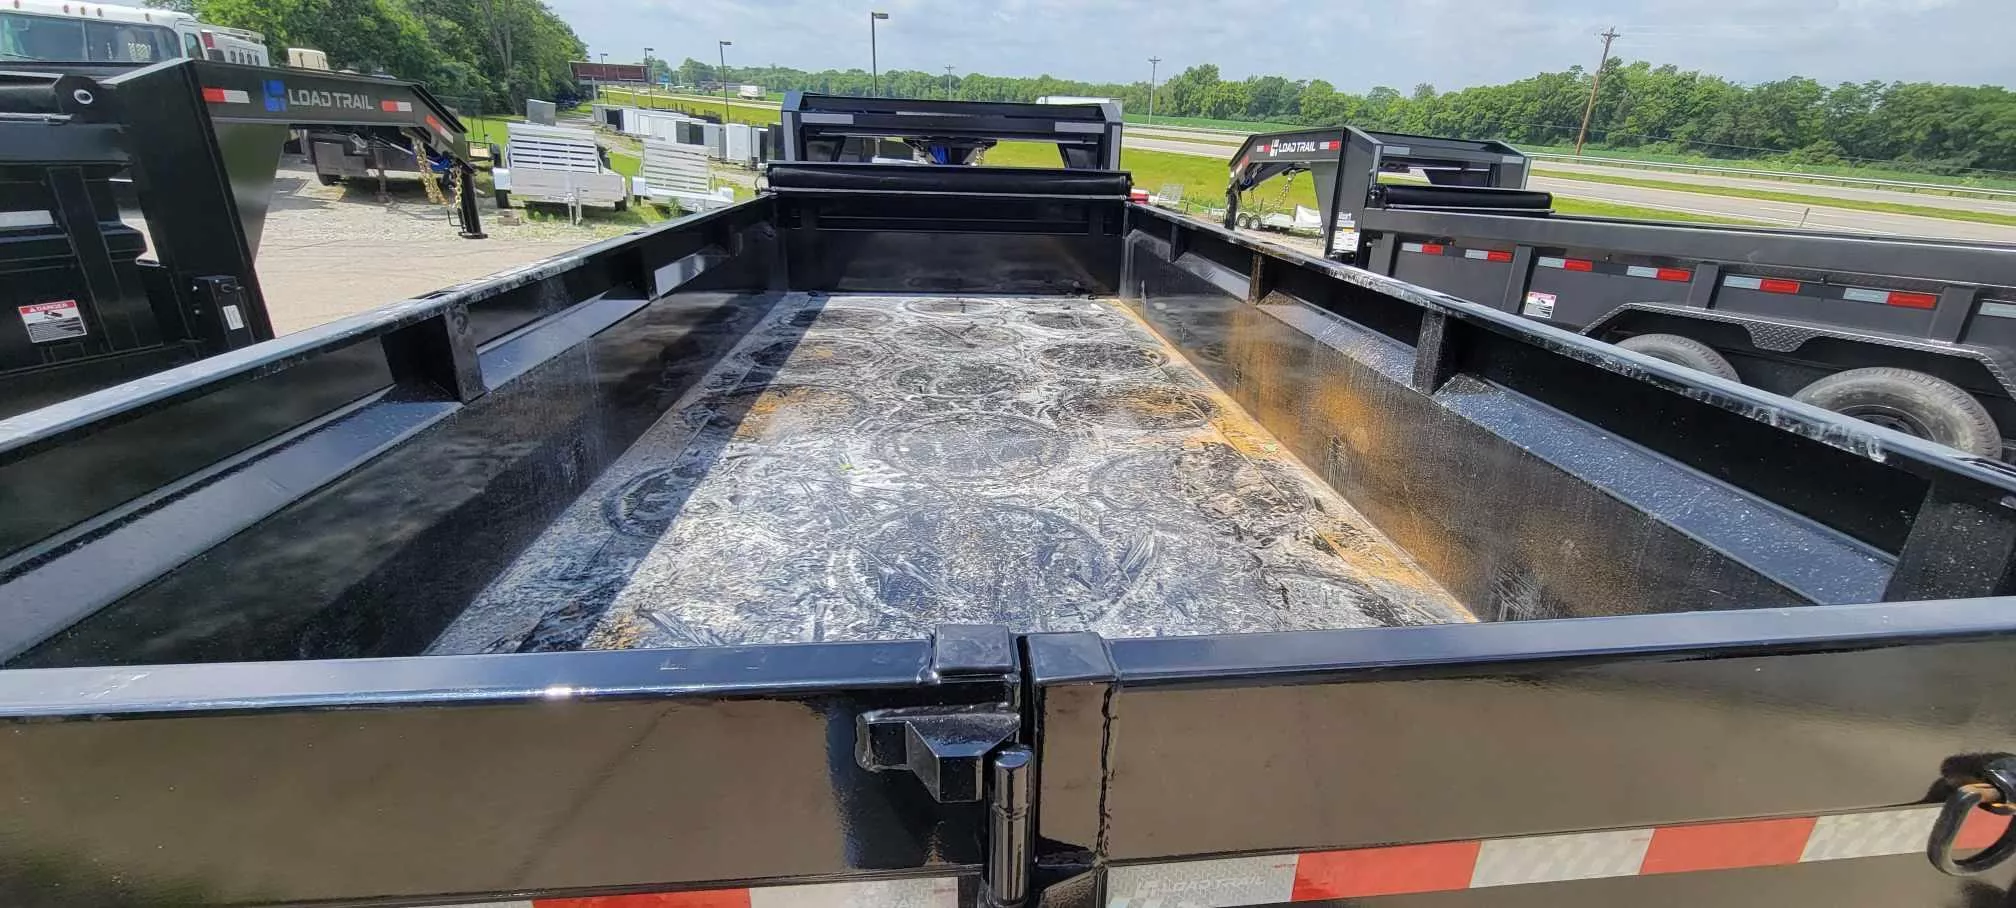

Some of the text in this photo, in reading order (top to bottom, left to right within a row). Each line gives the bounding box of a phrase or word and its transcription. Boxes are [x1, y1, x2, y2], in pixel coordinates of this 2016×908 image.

[288, 89, 374, 110] LOAD TRAIL
[1279, 141, 1316, 153] LOAD TRAIL
